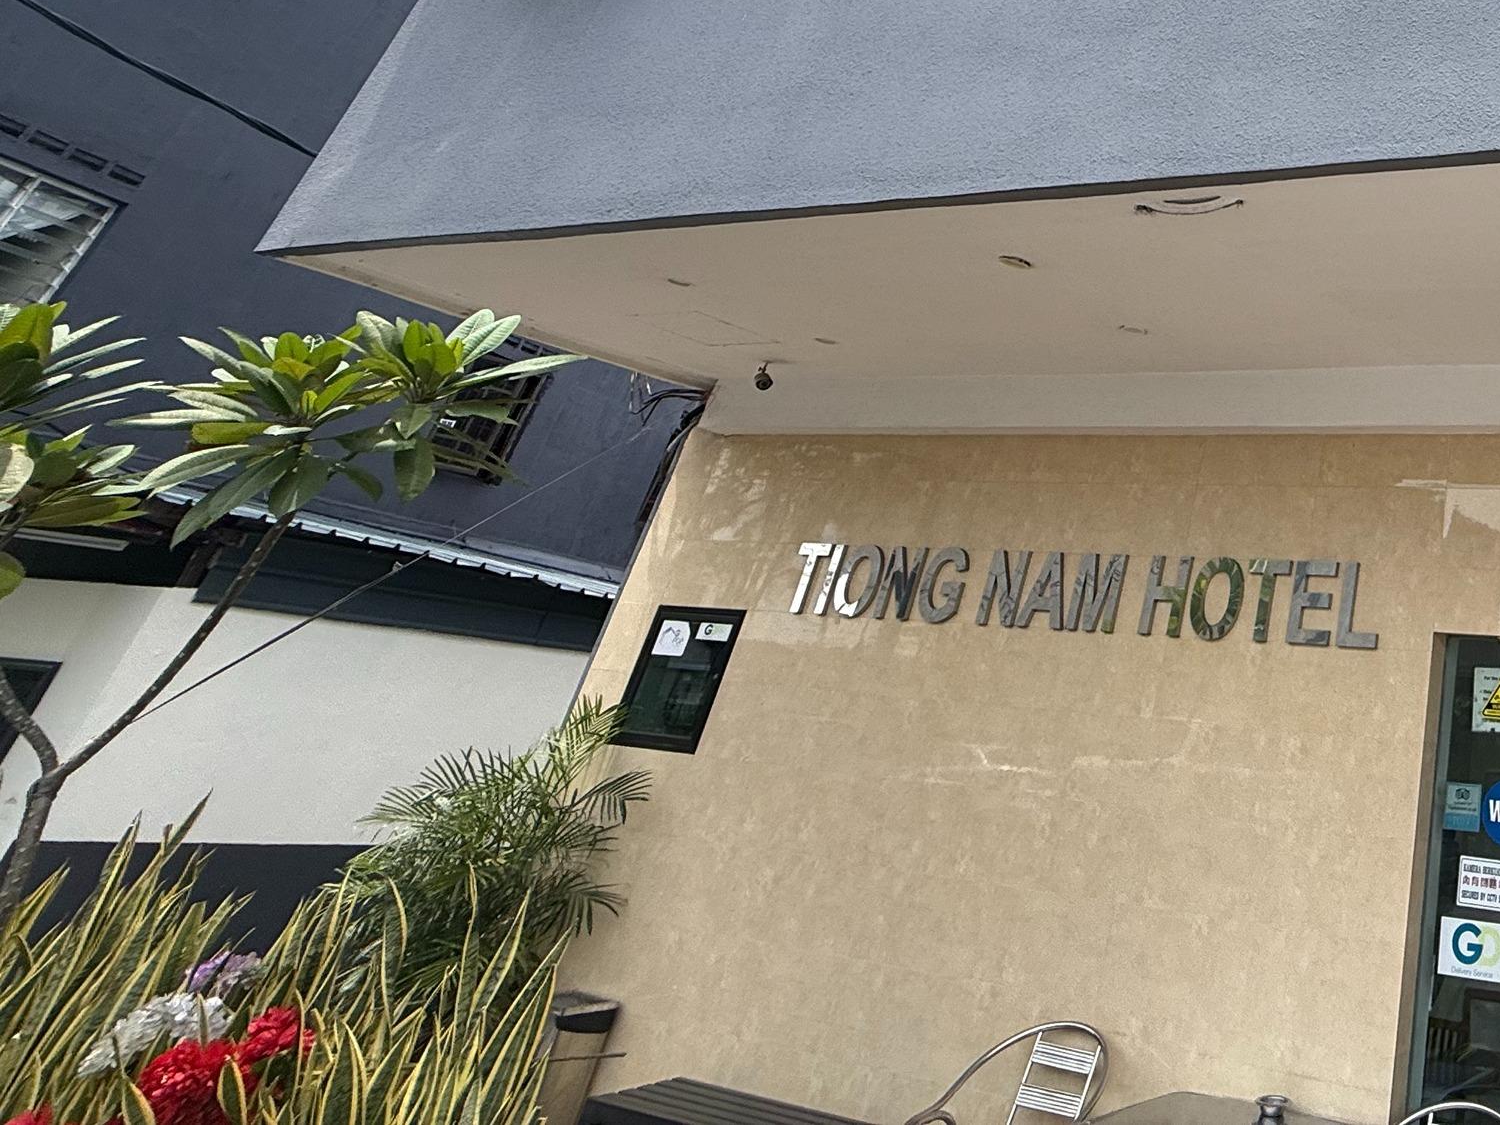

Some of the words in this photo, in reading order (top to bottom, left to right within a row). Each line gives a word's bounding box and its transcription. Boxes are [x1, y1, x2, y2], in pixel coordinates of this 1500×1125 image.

[788, 542, 970, 624] TIONG
[975, 548, 1129, 633] NAM
[1138, 554, 1379, 649] HOTEL
[1487, 893, 1497, 902] CCTV
